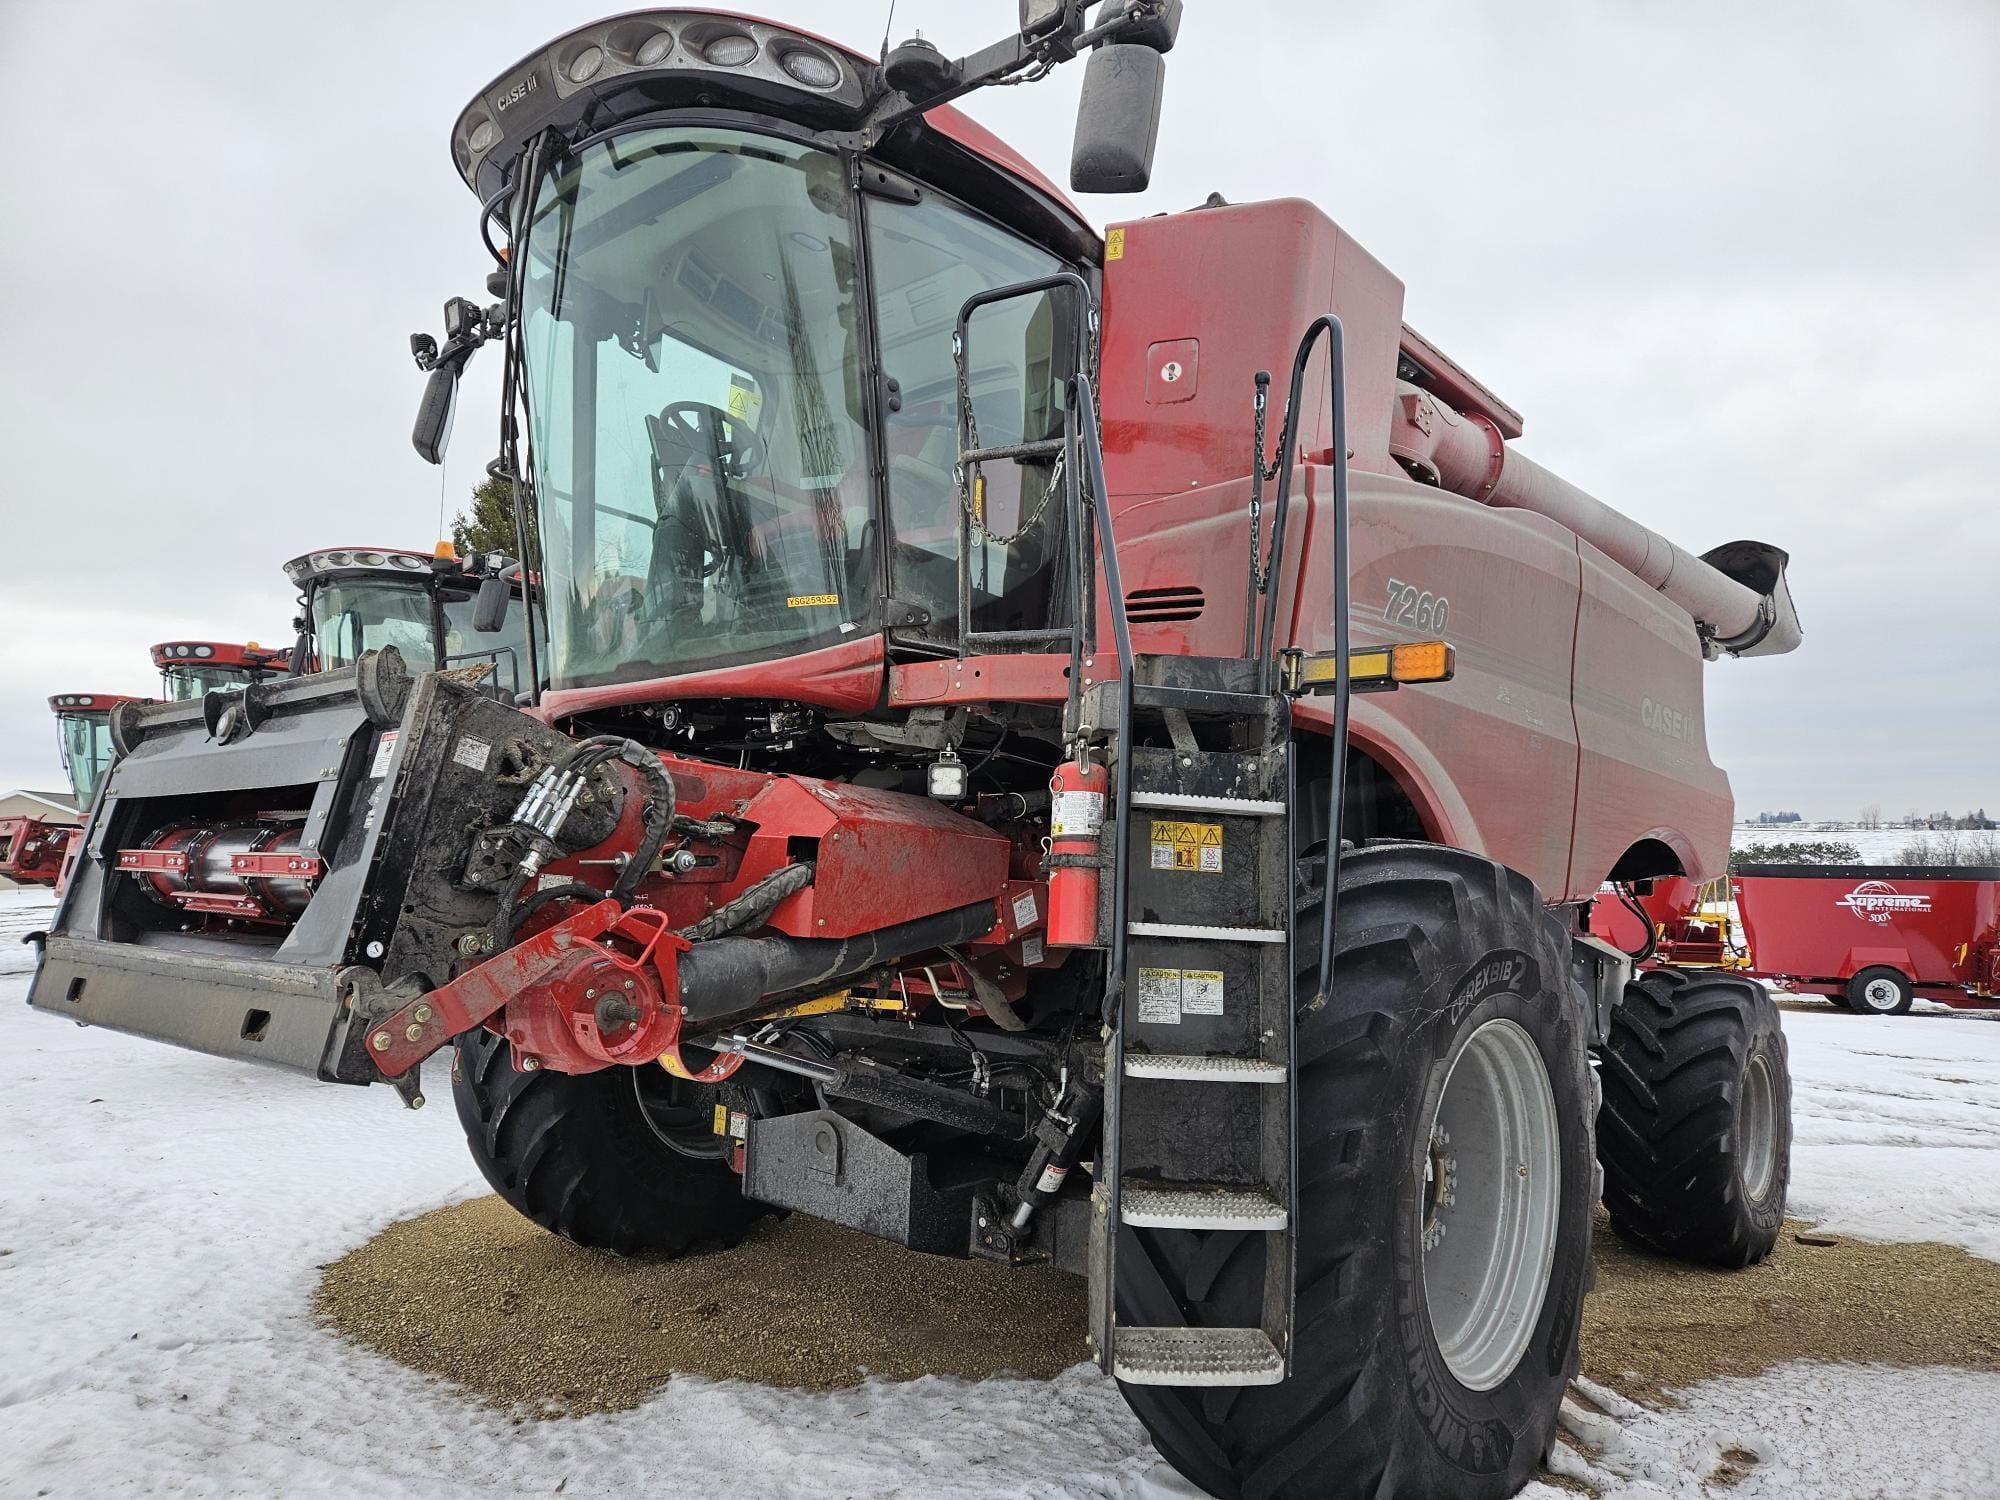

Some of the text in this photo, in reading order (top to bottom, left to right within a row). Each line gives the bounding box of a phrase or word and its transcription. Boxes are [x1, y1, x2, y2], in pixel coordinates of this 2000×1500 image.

[497, 82, 526, 111] CASE
[1383, 577, 1449, 637] 7260
[1641, 697, 1682, 741] CASE
[1836, 893, 1932, 911] Supreme
[1872, 905, 1932, 913] INTERNATIONAL
[1151, 970, 1177, 978] CAUTION
[1508, 955, 1527, 990] 2
